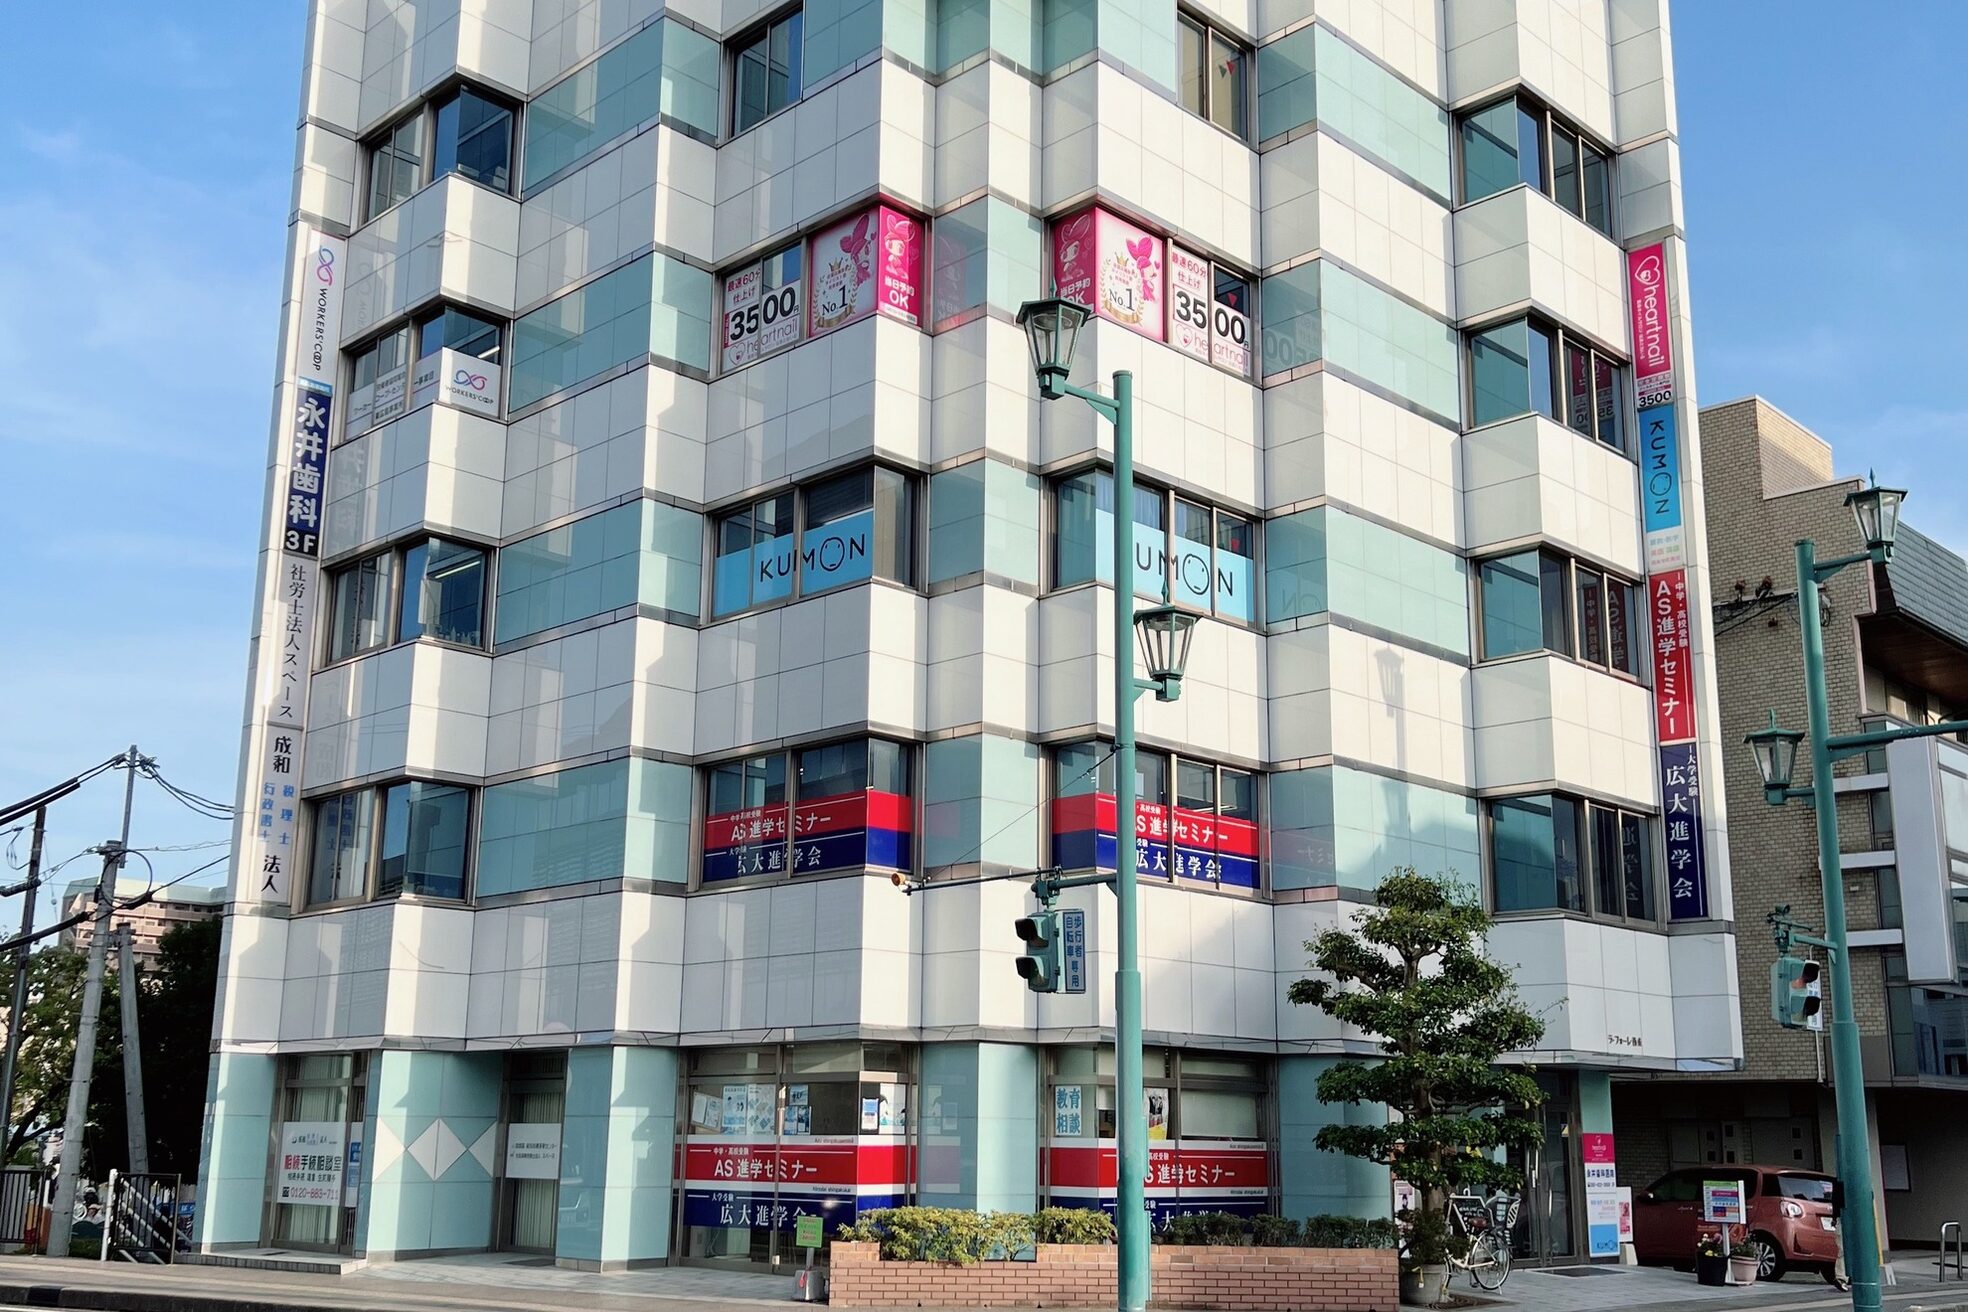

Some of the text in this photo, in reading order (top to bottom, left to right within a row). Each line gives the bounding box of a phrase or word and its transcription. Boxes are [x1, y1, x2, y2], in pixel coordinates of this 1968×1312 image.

[889, 290, 909, 310] OK
[1644, 284, 1665, 367] heartnail
[1639, 390, 1671, 408] 3500
[289, 397, 327, 528] 永井歯科
[1649, 420, 1672, 515] KUMON
[286, 530, 316, 553] 3F
[760, 533, 865, 583] KUMON
[1136, 541, 1234, 597] UMON
[1674, 582, 1689, 648] 中学・高校受験
[279, 563, 307, 718] 社労士法人スペース
[1656, 580, 1680, 734] AS進学セミナー
[273, 736, 293, 774] 成和
[1687, 755, 1699, 797] 大学受験
[1135, 815, 1228, 844] S進学セミナー
[1665, 766, 1693, 898] 広大進学会
[261, 855, 282, 893] 法人
[1057, 1088, 1081, 1109] 教育
[1057, 1113, 1081, 1134] 相談
